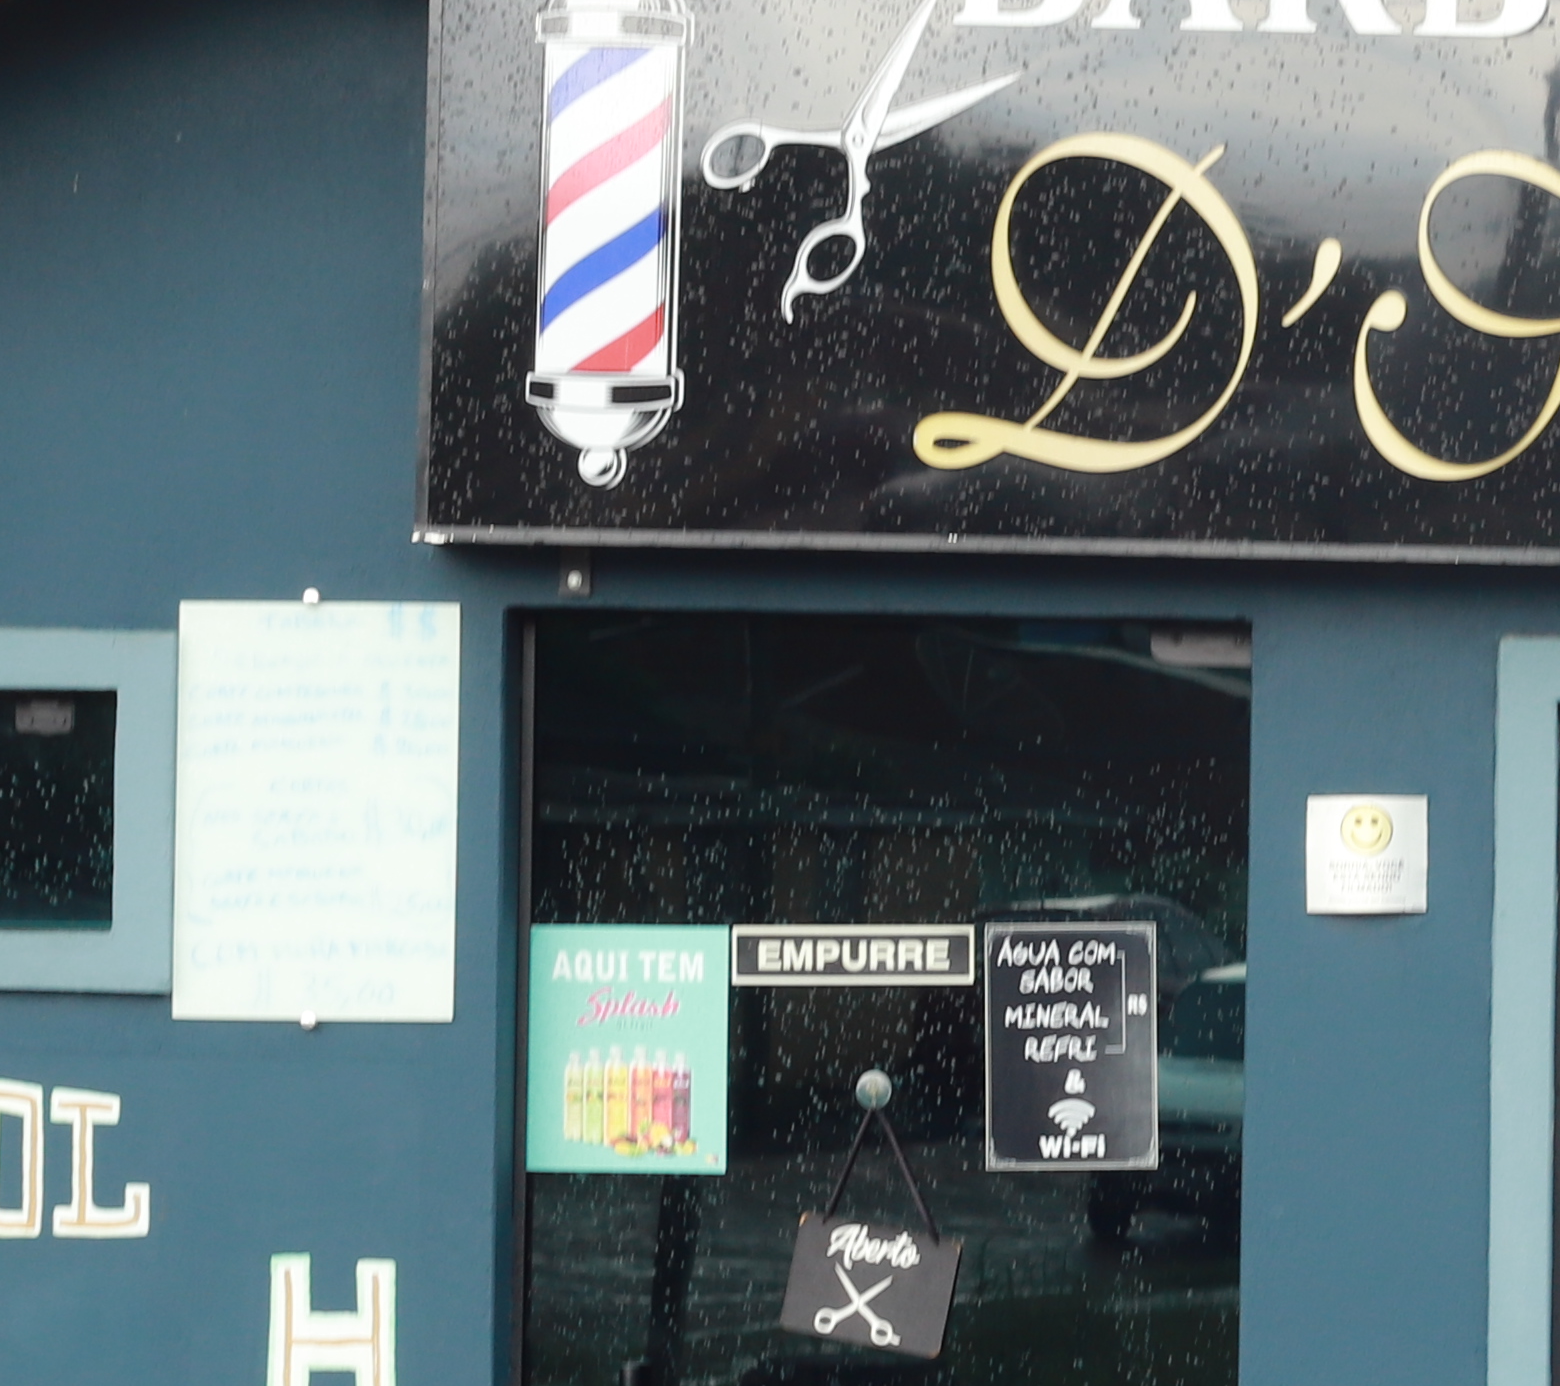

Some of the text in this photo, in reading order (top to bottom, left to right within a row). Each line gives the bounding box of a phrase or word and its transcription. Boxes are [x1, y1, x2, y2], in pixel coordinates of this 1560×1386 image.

[552, 949, 704, 983] AQUI TEM
[757, 939, 951, 972] EMPURRE
[577, 986, 681, 1027] Splash
[1004, 1000, 1110, 1029] MINERAL
[1024, 1034, 1098, 1063] REFRI
[827, 1223, 920, 1271] Aberto
